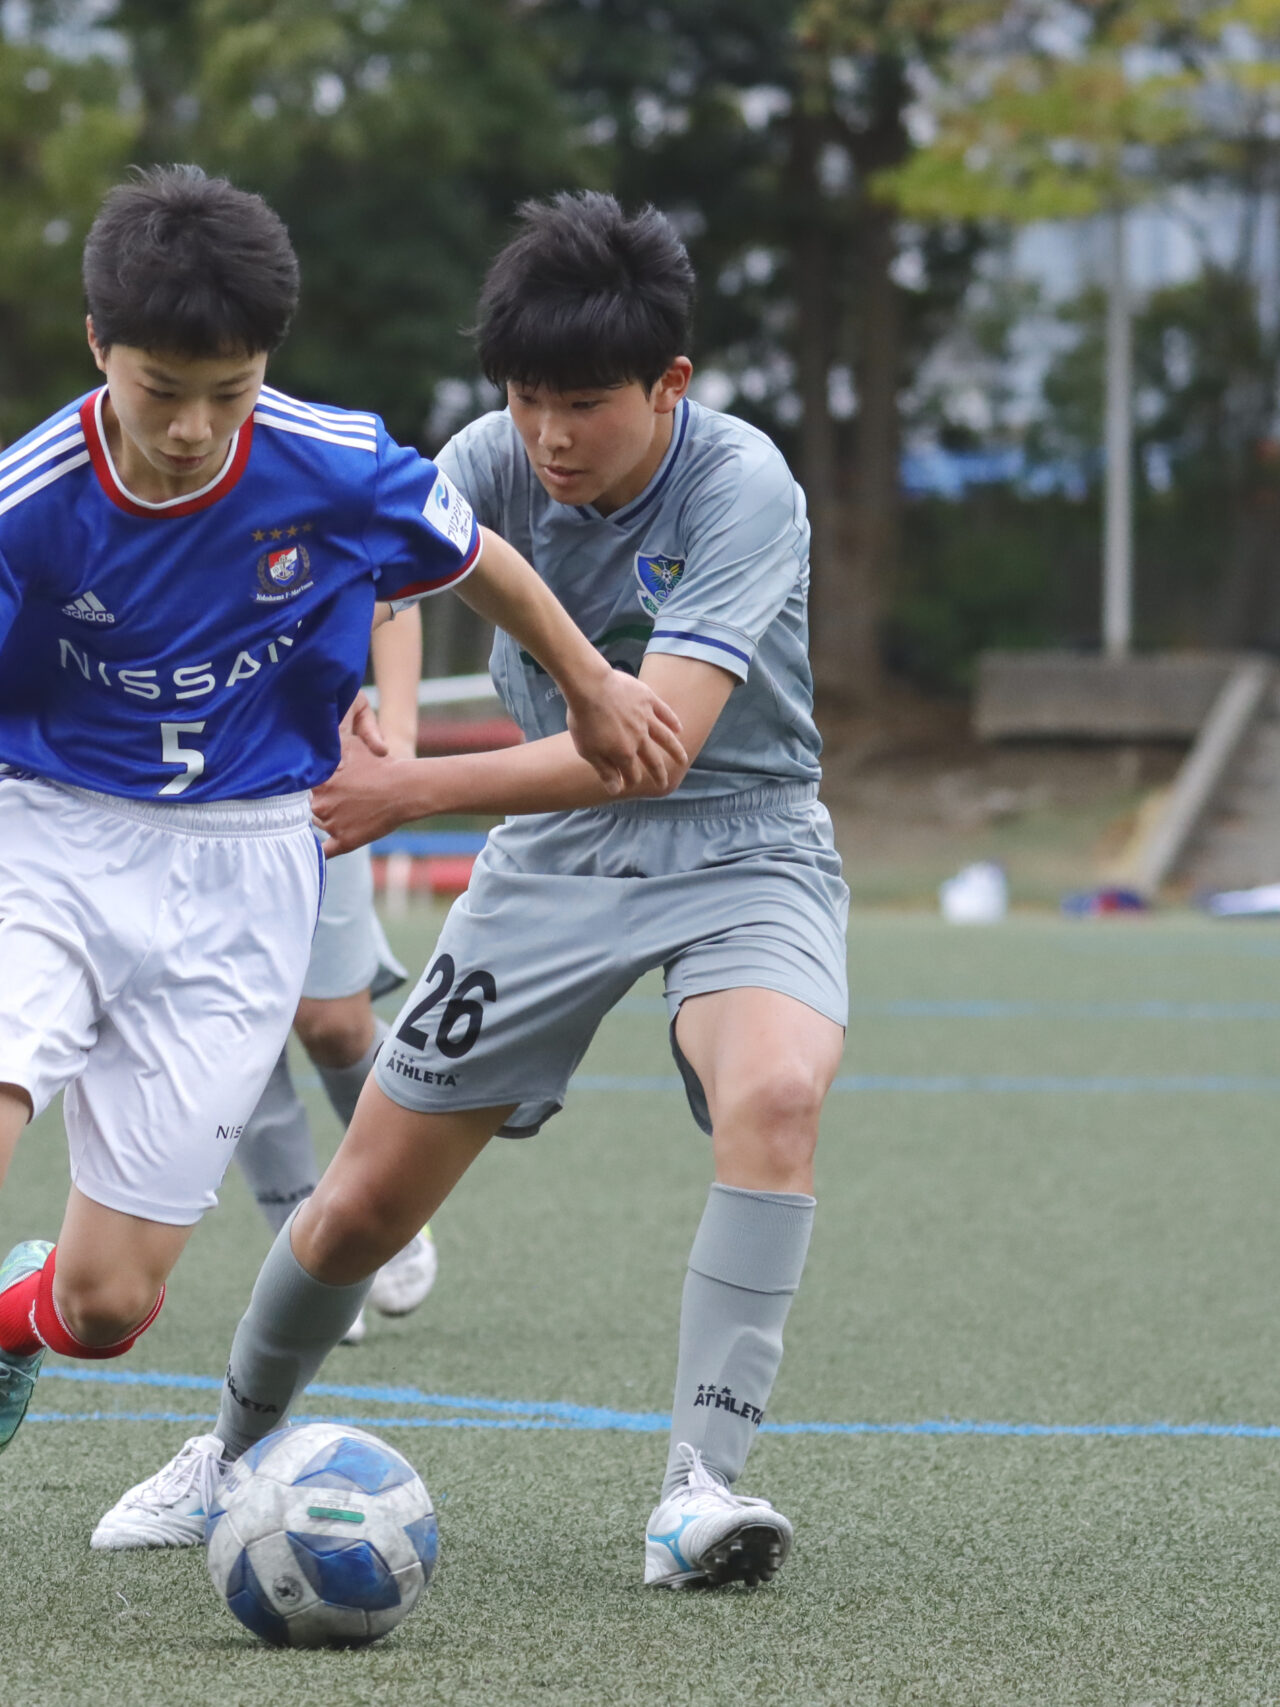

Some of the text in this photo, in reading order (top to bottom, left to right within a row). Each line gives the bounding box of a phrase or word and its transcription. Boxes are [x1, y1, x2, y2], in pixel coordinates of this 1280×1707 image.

[63, 608, 116, 623] adidas
[157, 720, 207, 796] 5
[396, 953, 497, 1059] 26
[385, 1057, 460, 1087] ATHLETA
